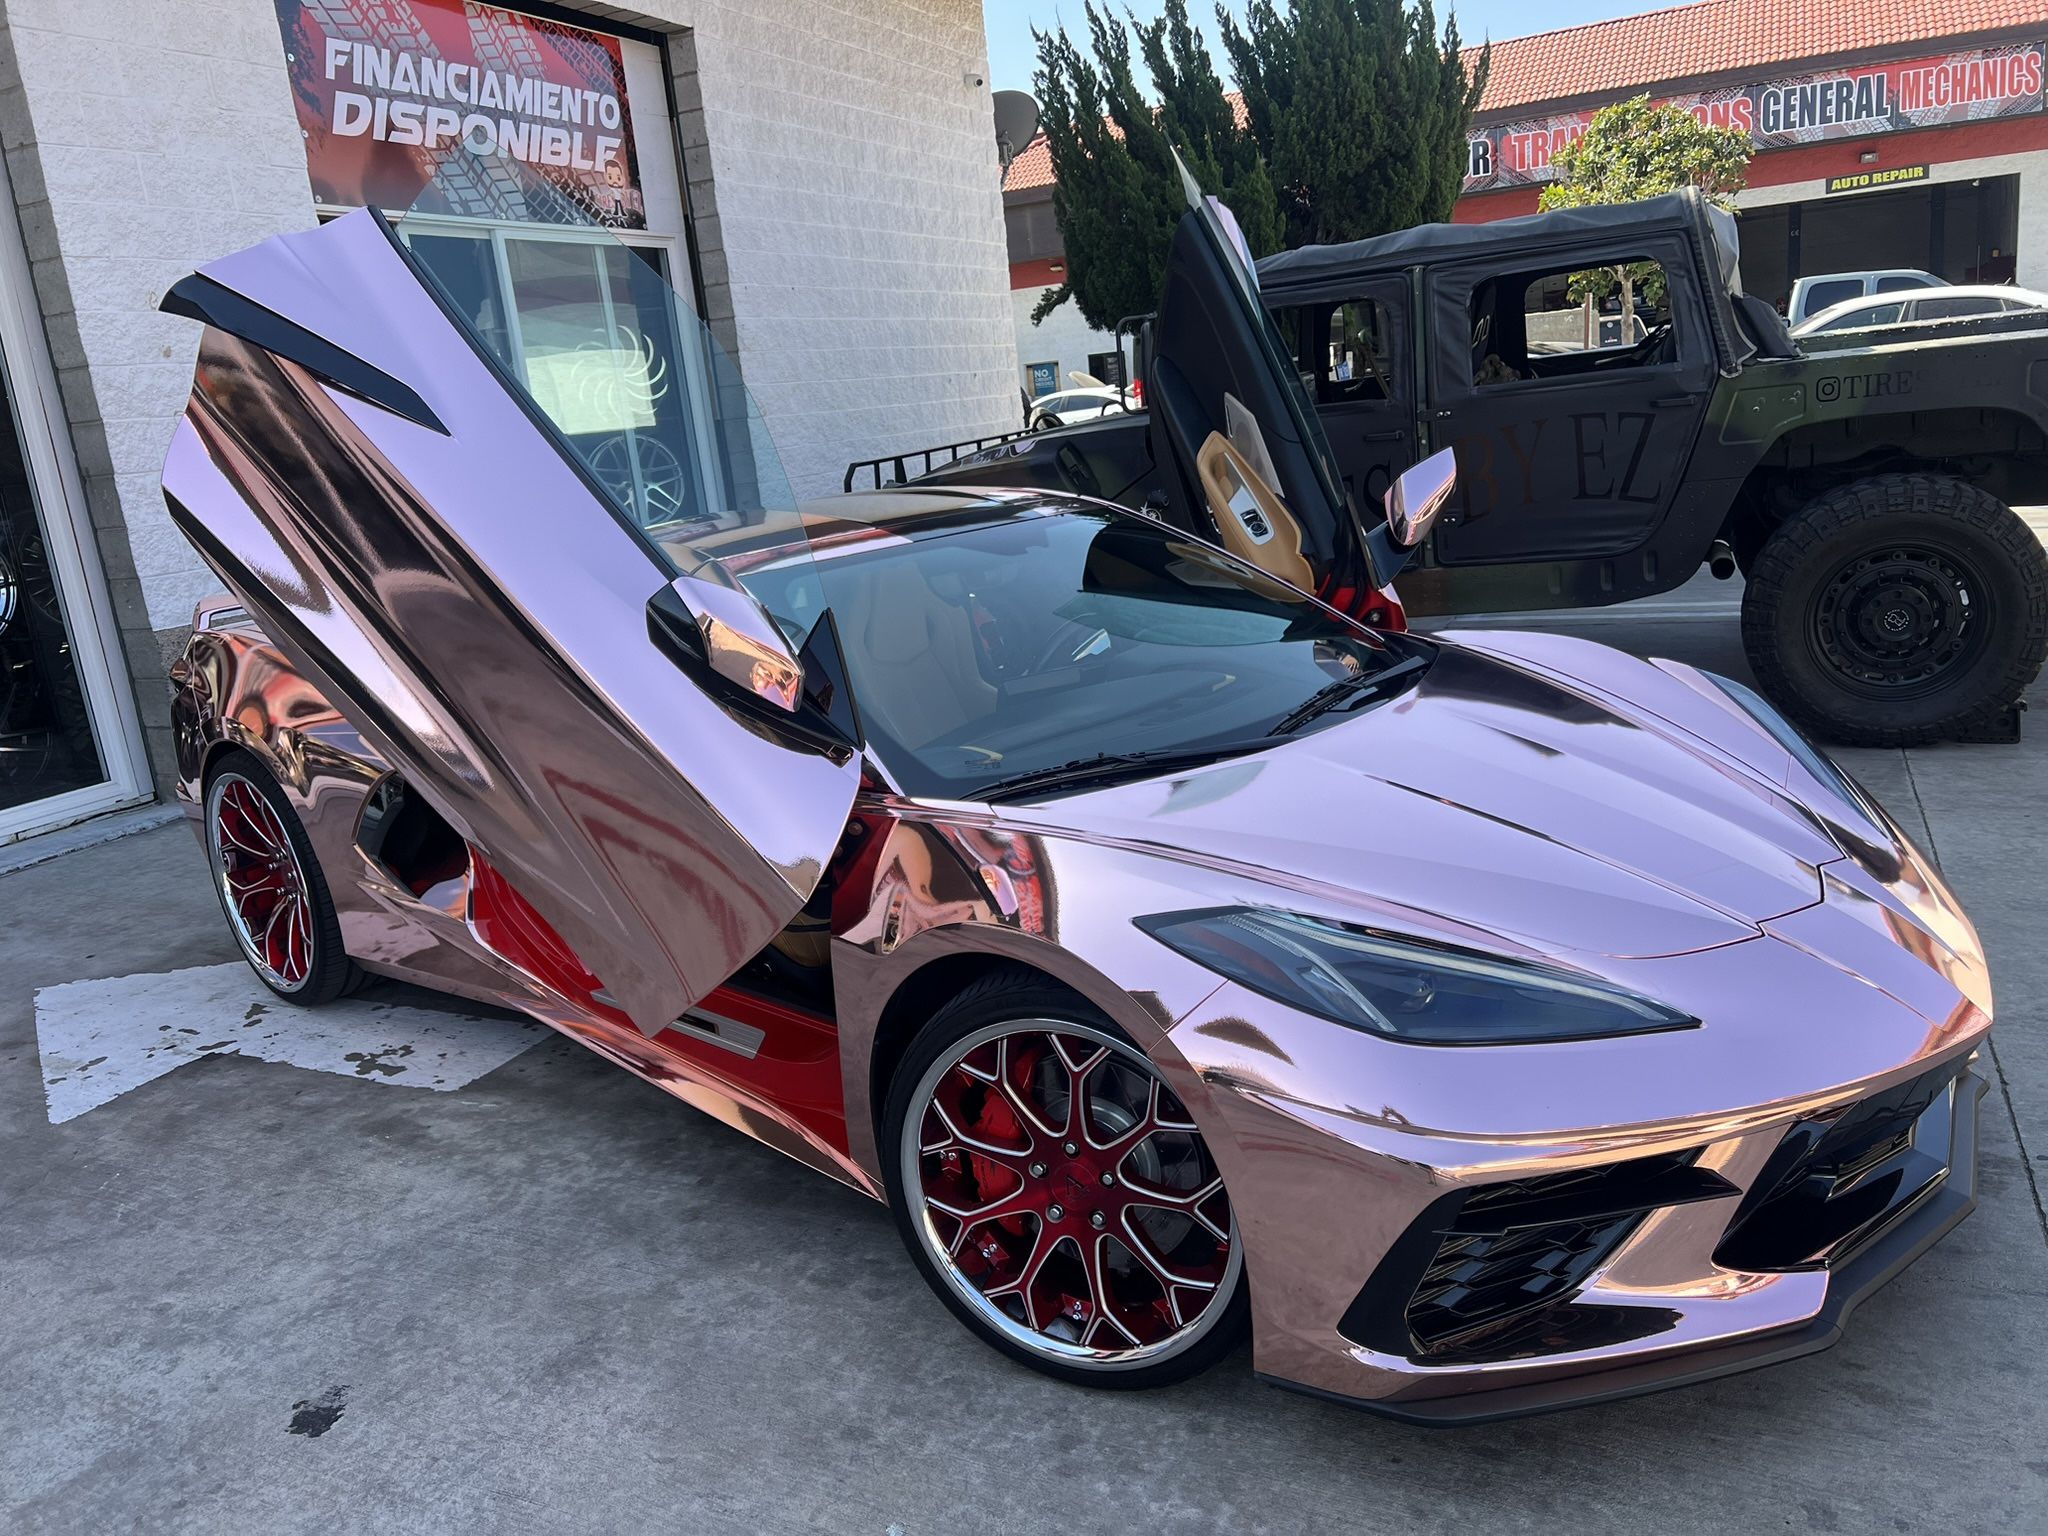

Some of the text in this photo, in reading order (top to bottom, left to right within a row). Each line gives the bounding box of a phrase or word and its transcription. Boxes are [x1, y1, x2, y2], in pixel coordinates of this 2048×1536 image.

[325, 37, 621, 130] FINANCIAMIENTO
[1761, 73, 1891, 135] GENERAL
[1900, 51, 2042, 113] MECHANICS
[332, 90, 622, 172] DISPONIBLE
[1832, 166, 1924, 190] AUTO REPAIR
[1034, 369, 1049, 378] NO
[1568, 412, 1662, 504] EZ
